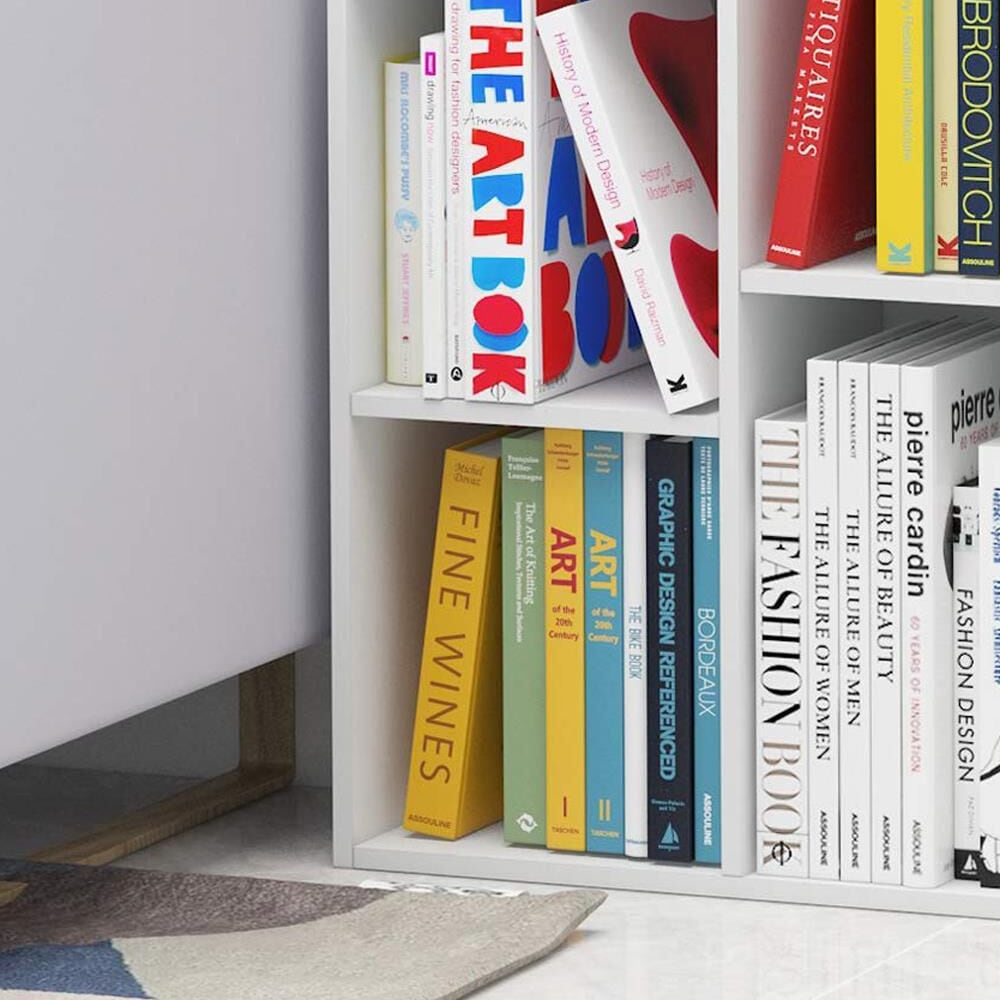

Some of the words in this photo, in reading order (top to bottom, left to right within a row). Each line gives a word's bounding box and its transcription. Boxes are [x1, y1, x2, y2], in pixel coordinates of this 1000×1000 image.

[449, 2, 461, 54] drawing
[803, 12, 815, 53] FLEA
[450, 58, 461, 76] for
[553, 31, 578, 82] History
[450, 80, 461, 128] fashion
[573, 84, 586, 100] of
[787, 69, 806, 151] MARKETS
[579, 101, 609, 163] Modern
[449, 131, 461, 195] designers
[471, 128, 525, 246] ART
[598, 159, 621, 209] Design
[771, 243, 801, 257] ASSOULINE
[962, 257, 995, 267] ASSOULINE
[471, 256, 529, 396] BOOK
[633, 267, 652, 295] David
[645, 296, 668, 347] Raizman
[666, 374, 688, 393] K
[876, 394, 893, 443] THE
[951, 386, 995, 443] pierre
[761, 429, 800, 520] THE
[904, 412, 929, 498] pierre
[525, 502, 536, 523] The
[876, 449, 893, 542] ALLURE
[526, 525, 536, 544] Art
[658, 478, 675, 566] GRAPHIC
[815, 506, 829, 550] THE
[846, 508, 860, 552] THE
[439, 504, 479, 610] FINE
[526, 547, 536, 559] of
[550, 527, 577, 594] ART
[589, 529, 617, 597] ART
[876, 549, 893, 580] OF
[907, 506, 929, 597] cardin
[524, 560, 536, 605] Knitting
[815, 556, 830, 638] ALLURE
[846, 558, 860, 640] ALLURE
[552, 605, 562, 616] of
[564, 605, 575, 616] the
[555, 616, 573, 628] 20th
[630, 606, 642, 624] THE
[658, 573, 676, 645] DESIGN
[760, 530, 802, 728] FASHION
[549, 629, 579, 642] Century
[630, 627, 642, 653] BIKE
[815, 645, 830, 673] OF
[846, 646, 860, 674] OF
[877, 587, 893, 683] BEAUTY
[957, 588, 974, 690] FASHION
[630, 656, 642, 680] BOOK
[698, 608, 716, 717] BORDEAUX
[419, 633, 466, 785] WINES
[659, 650, 676, 782] REFERENCED
[816, 678, 831, 761] WOMEN
[847, 679, 860, 726] MEN
[958, 697, 975, 783] DESIGN
[408, 813, 451, 829] ASSOULINE
[591, 827, 619, 839] TASCHEN
[703, 793, 712, 846] ASSOULINE
